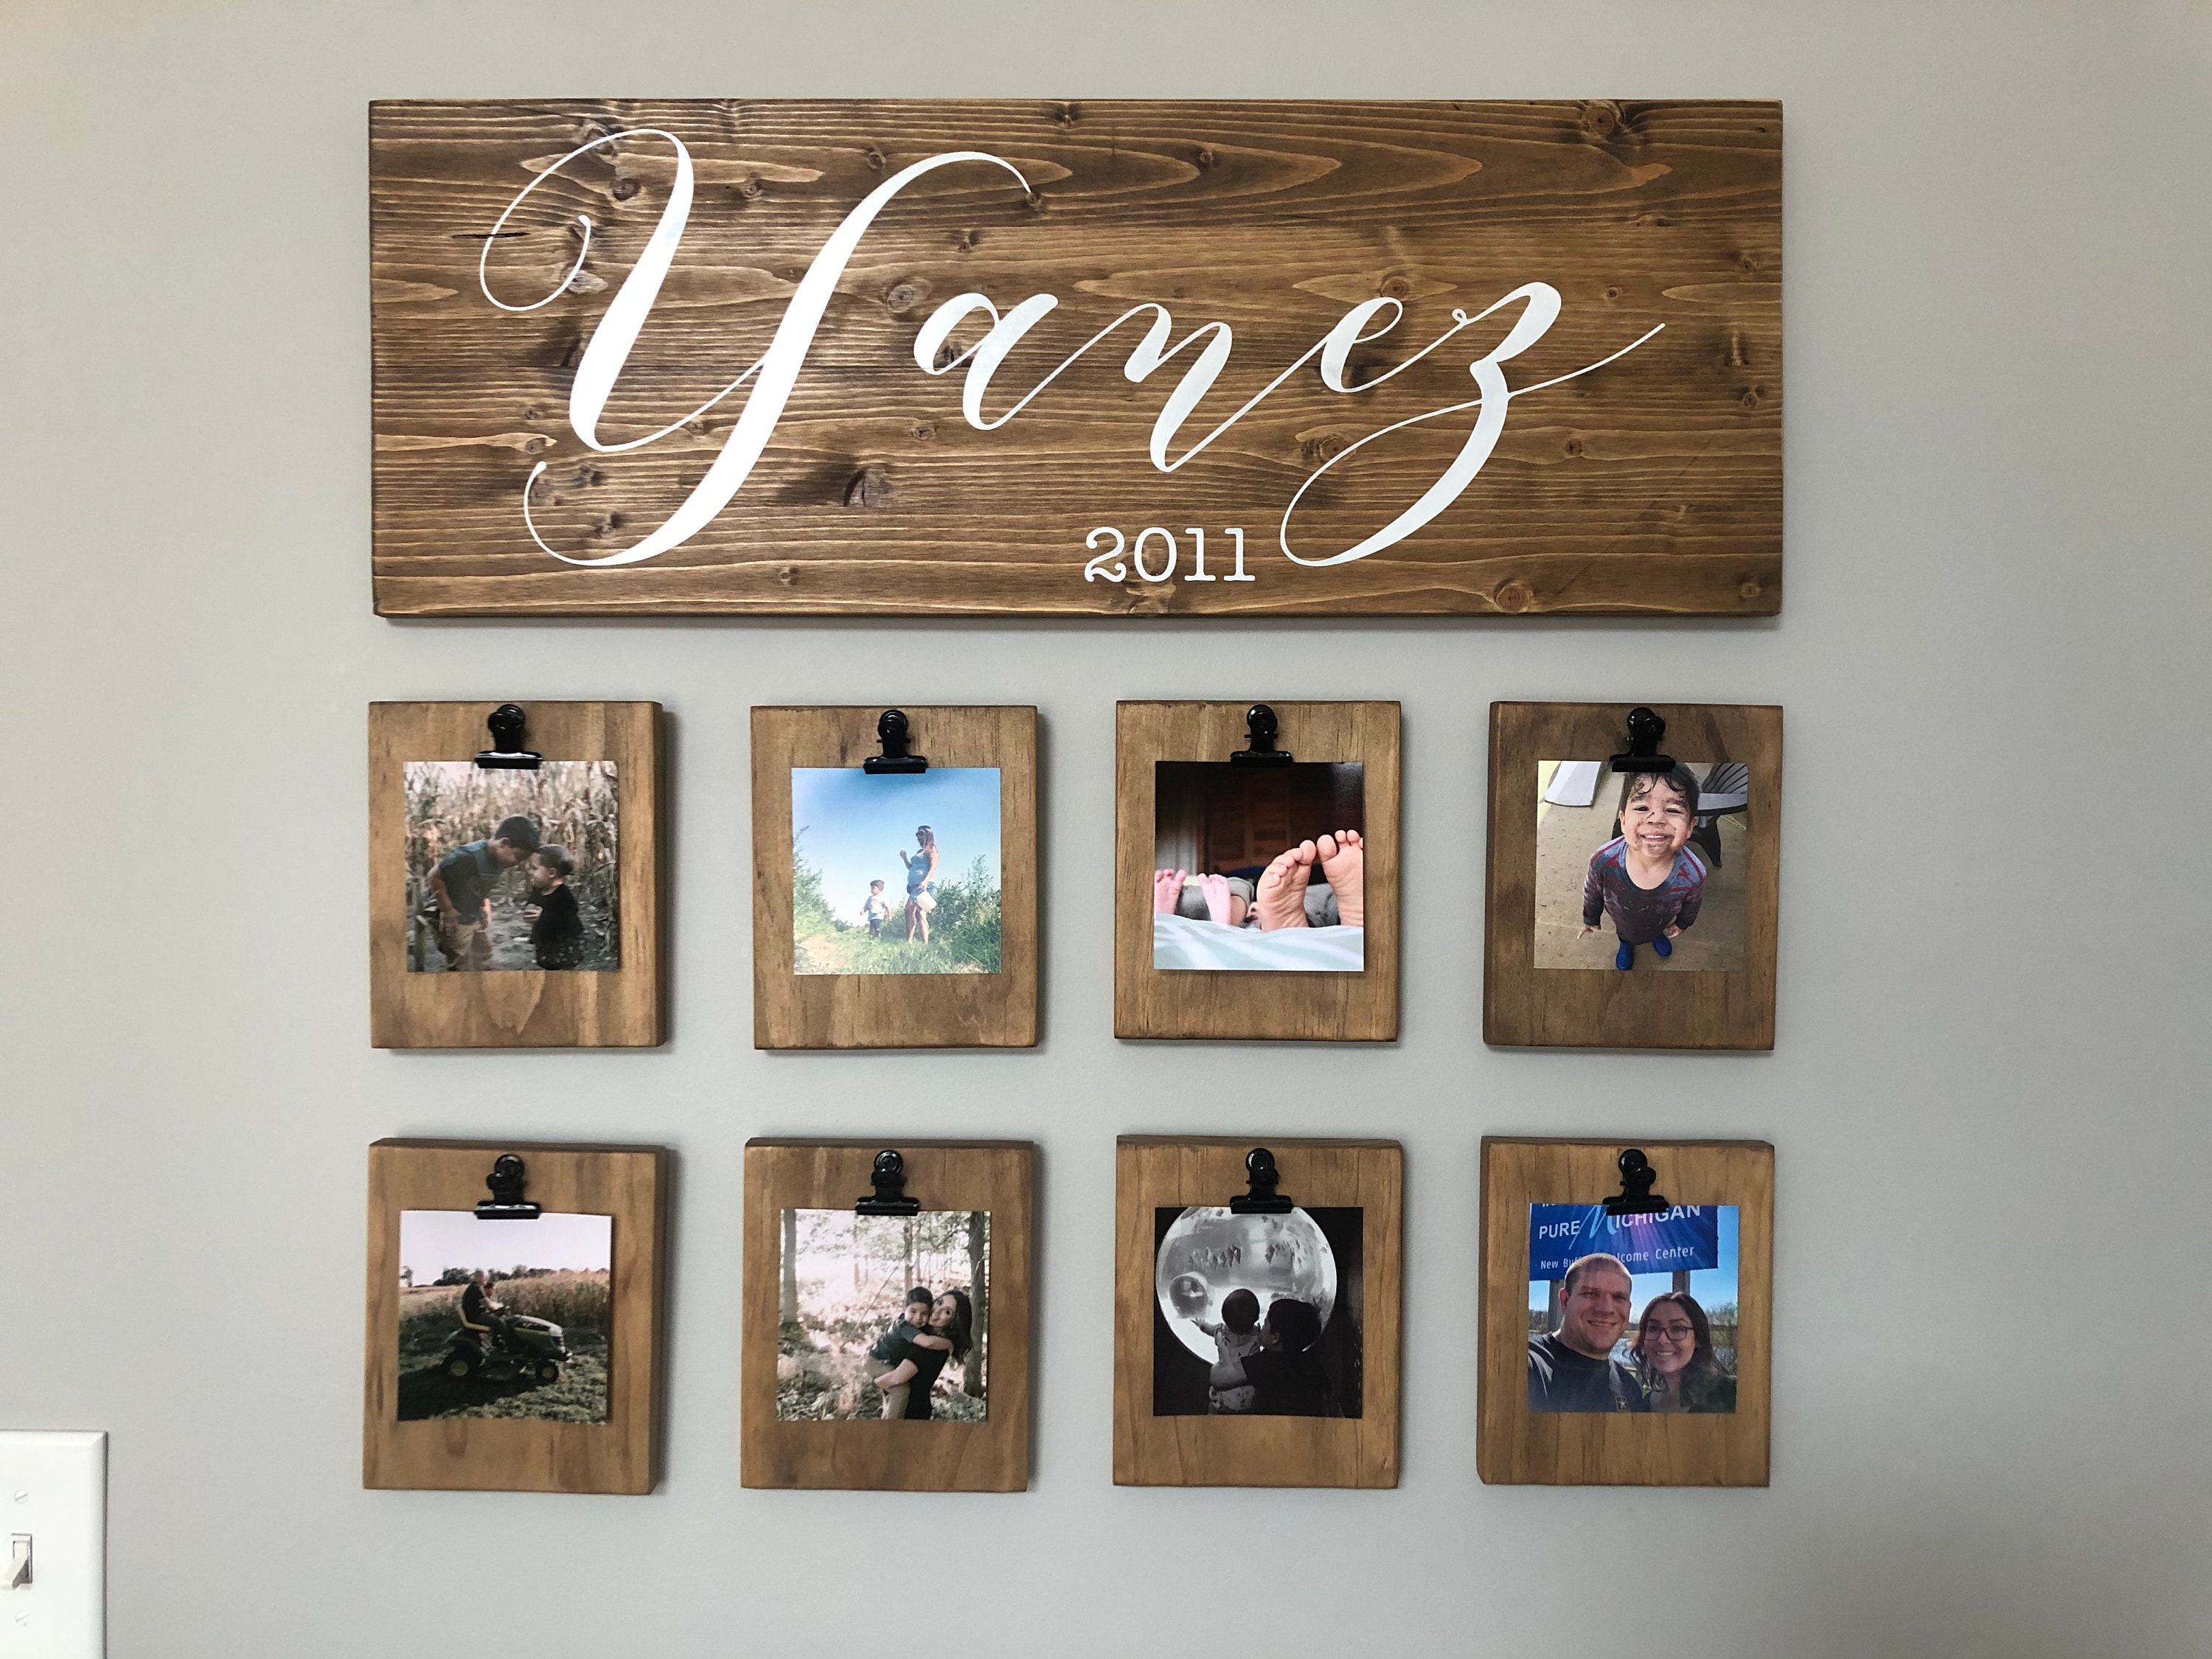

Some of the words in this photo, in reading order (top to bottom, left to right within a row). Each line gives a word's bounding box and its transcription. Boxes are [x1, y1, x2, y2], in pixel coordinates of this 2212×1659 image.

[479, 128, 1666, 567] Yanez
[1084, 526, 1256, 582] 2011
[1539, 1220, 1581, 1239] PURE
[1540, 1260, 1559, 1270] New
[1655, 1246, 1694, 1259] Center
